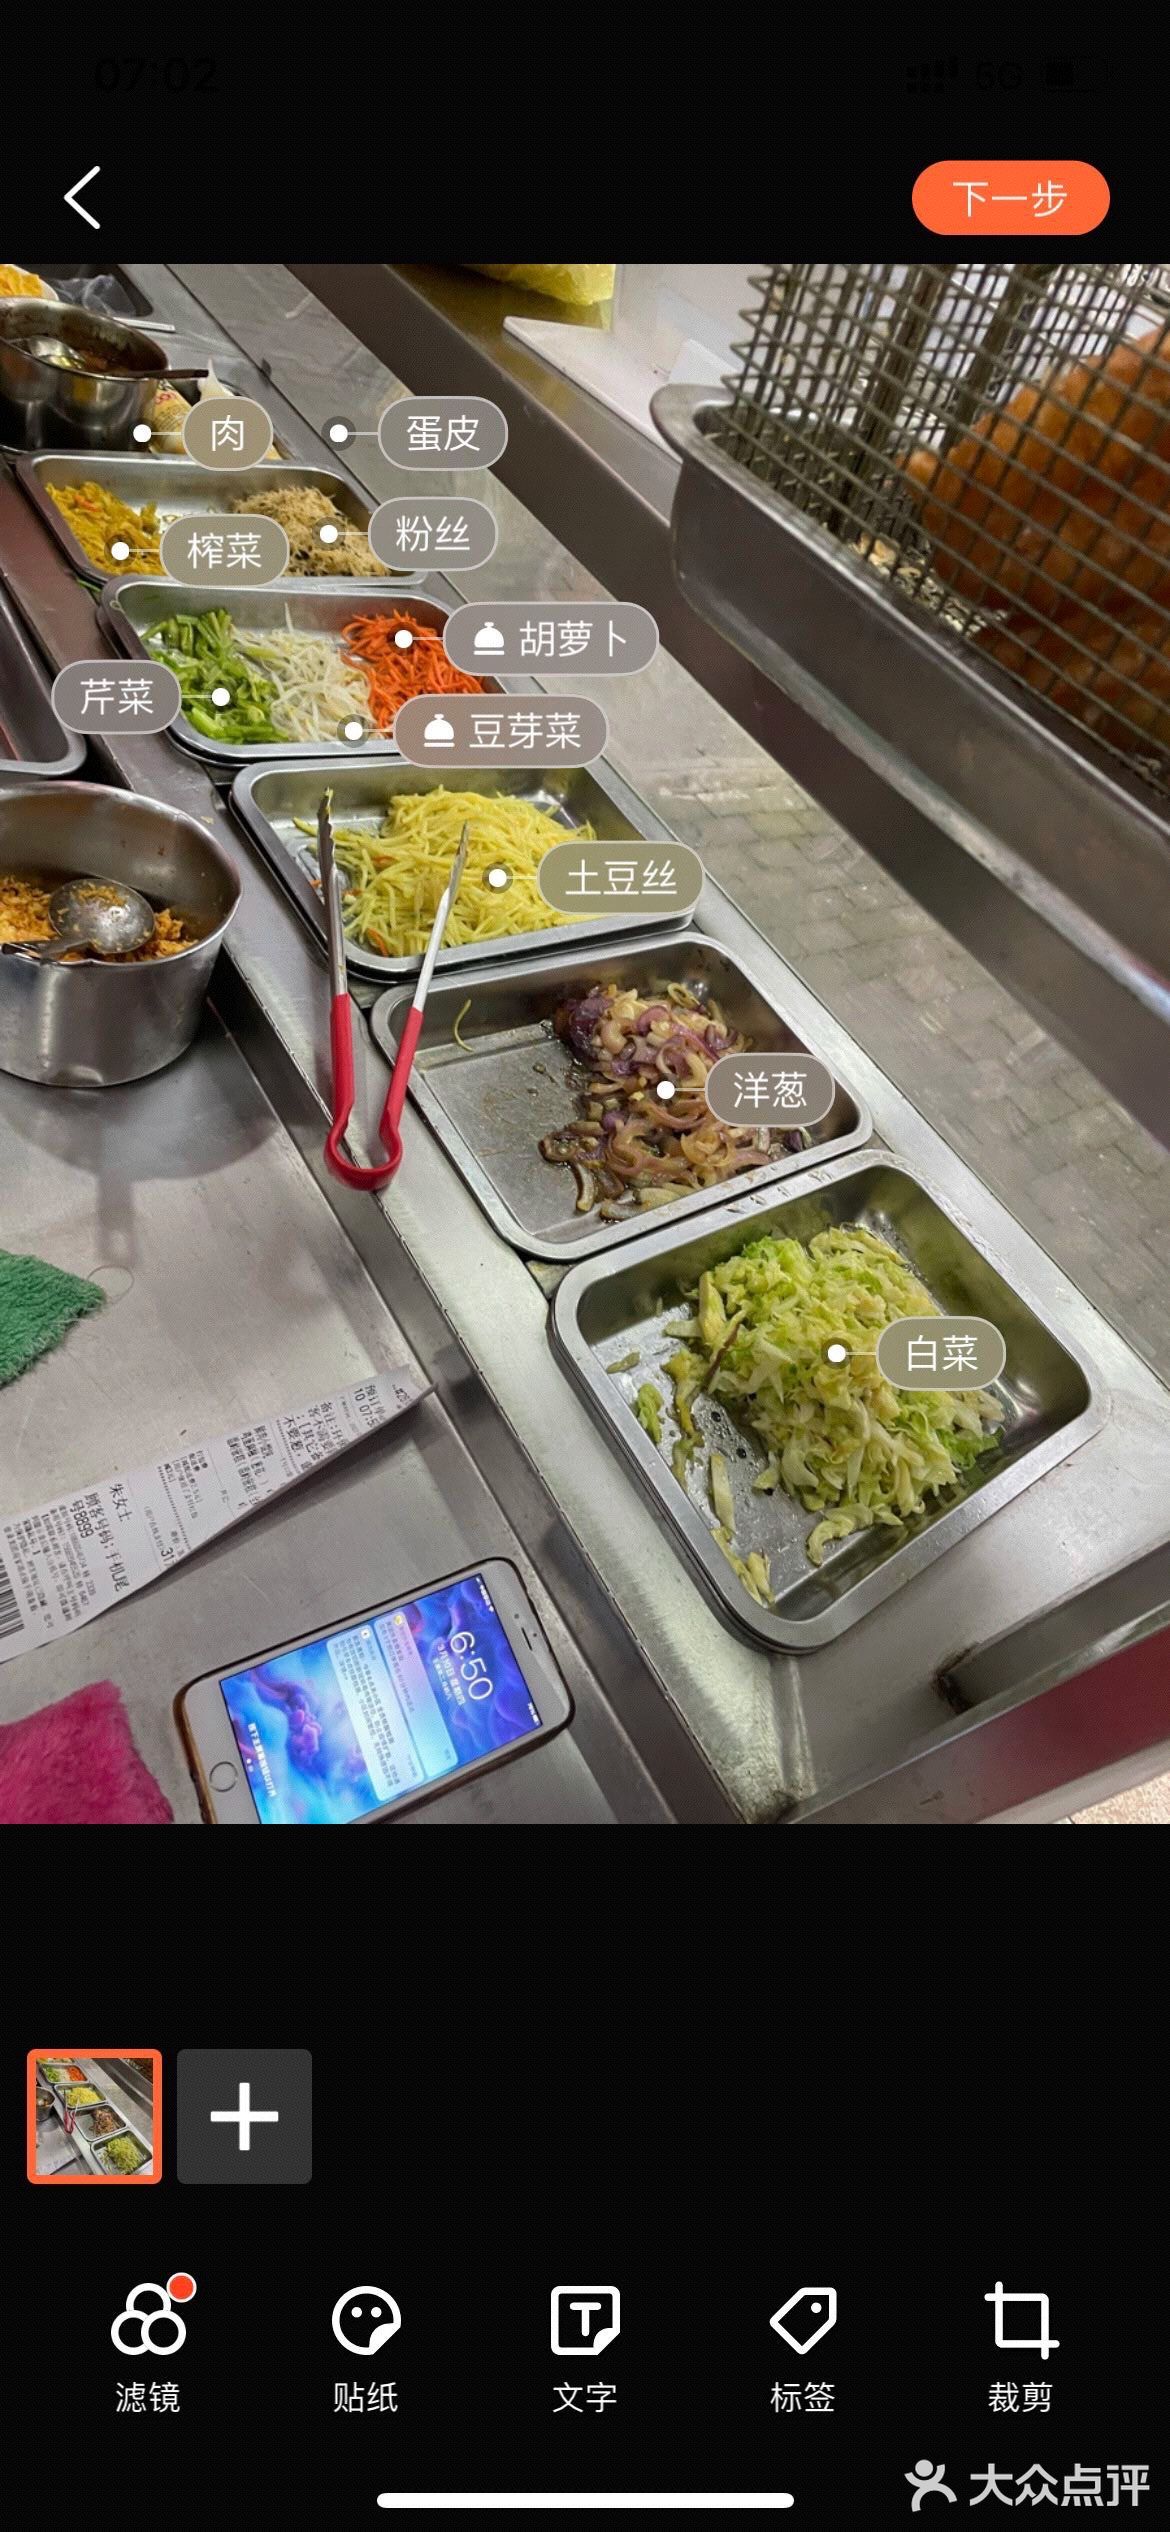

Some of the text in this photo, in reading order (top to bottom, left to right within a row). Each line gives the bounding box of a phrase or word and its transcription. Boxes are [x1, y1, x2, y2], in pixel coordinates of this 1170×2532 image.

[67, 1499, 94, 1538] 号8899
[108, 1482, 133, 1522] 朱女士
[450, 1631, 494, 1700] 6:50
